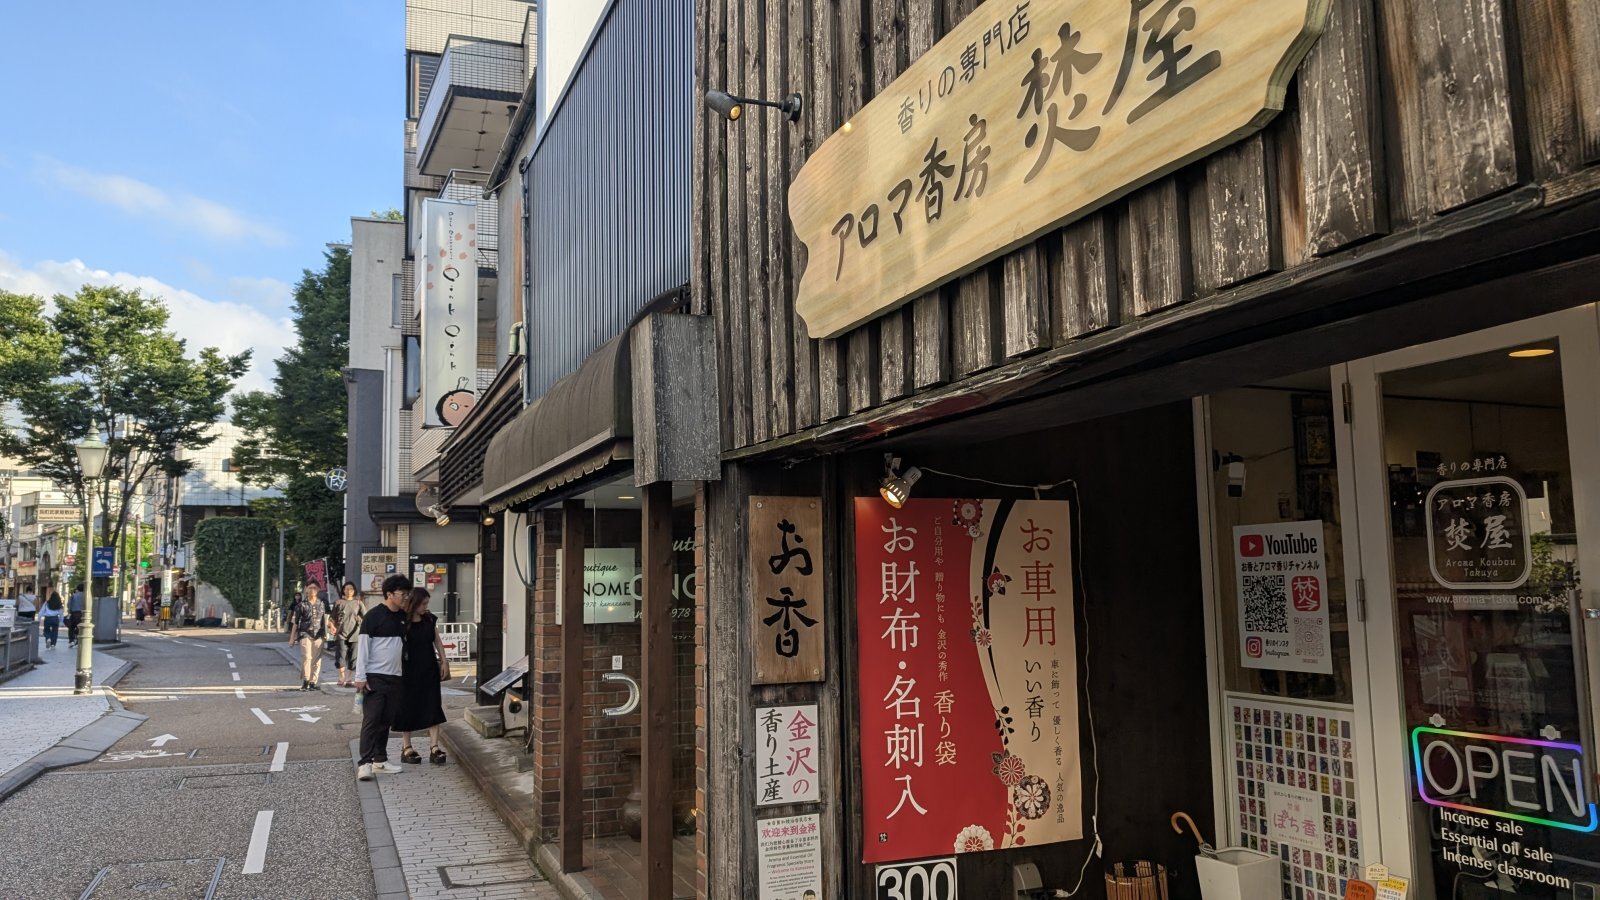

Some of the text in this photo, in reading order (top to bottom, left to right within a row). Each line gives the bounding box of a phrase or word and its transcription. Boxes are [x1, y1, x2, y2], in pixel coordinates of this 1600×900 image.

[897, 1, 1031, 136] 香りの専門店
[830, 0, 1221, 281] アロマ香房 焚屋
[1436, 455, 1508, 476] 香りの専門店
[1437, 491, 1512, 511] アロマ香房
[1265, 532, 1318, 555] YouTube
[1444, 515, 1513, 551] 焚屋
[363, 564, 394, 573] 近い P
[583, 562, 619, 576] outique
[1241, 559, 1319, 572] お香とアロマ香りチャンネル
[1445, 557, 1517, 567] Aroma Koubou
[1464, 568, 1499, 578] Takuya
[583, 582, 631, 597] NOME
[763, 519, 819, 658] お香
[933, 517, 948, 682] ご自分用や 贈り物にも 金沢の秀作
[1019, 518, 1056, 648] お車用
[671, 607, 691, 618] 978
[879, 517, 928, 820] お財布・名刺入
[1024, 659, 1045, 743] いい香り
[933, 690, 957, 766] 香り袋
[1050, 659, 1065, 823] 車に飾って 優しく香る 人気の逸品
[760, 708, 784, 802] 香り土産
[785, 709, 817, 796] 金沢の
[1423, 740, 1586, 818] OPEN
[761, 822, 817, 839] 欢迎来到金泽
[1440, 807, 1524, 836] Incense sale
[1441, 827, 1554, 864] Essential oil sale
[879, 863, 955, 900] 300
[1442, 847, 1570, 890] Incense classroom
